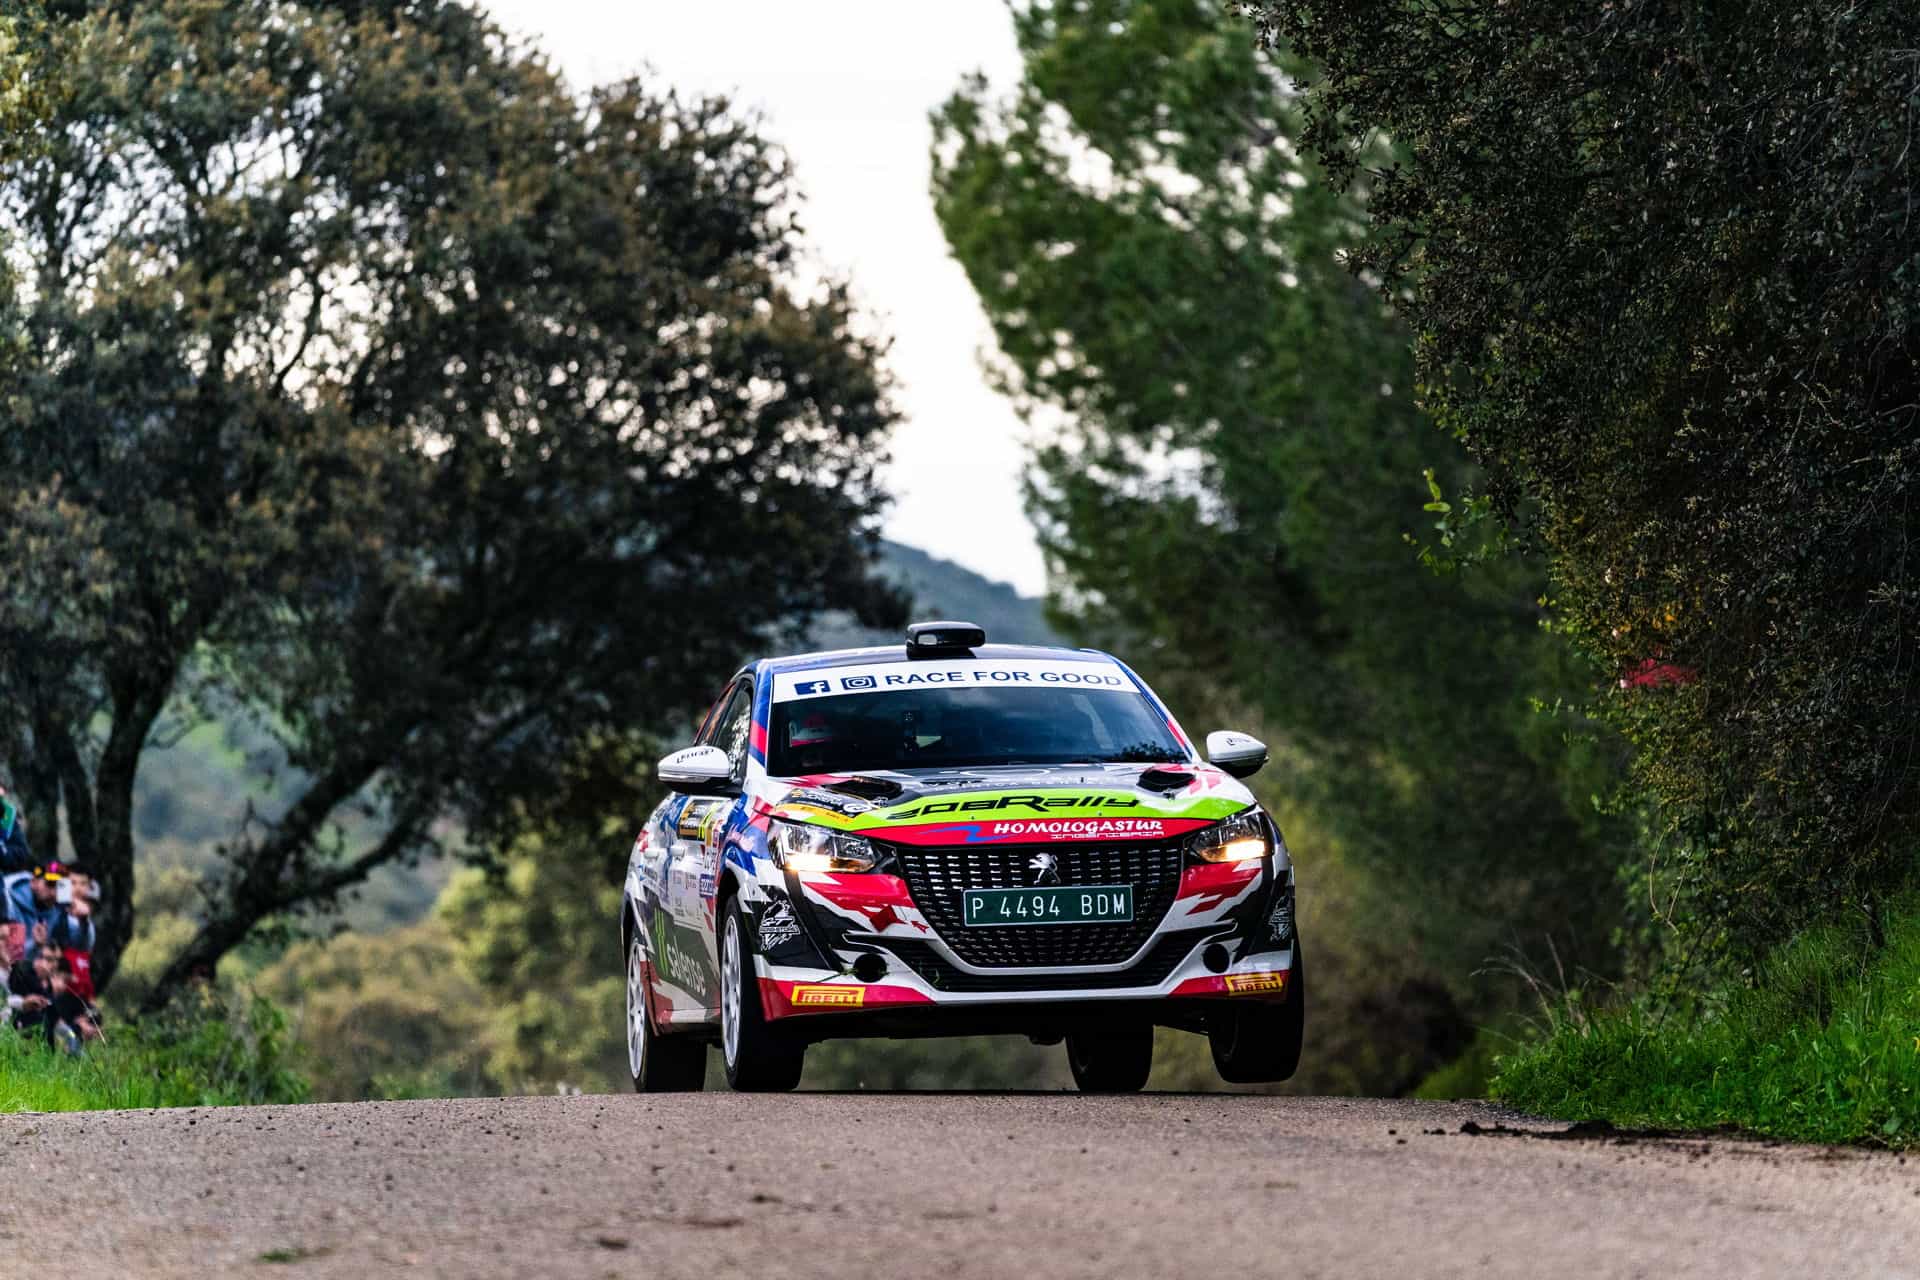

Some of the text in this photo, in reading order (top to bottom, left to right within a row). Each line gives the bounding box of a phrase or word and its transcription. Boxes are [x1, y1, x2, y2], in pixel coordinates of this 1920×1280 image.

[885, 671, 963, 686] RACE
[973, 670, 1030, 683] FOR
[1040, 671, 1122, 687] GOOD
[993, 819, 1164, 836] HOMOLOGASTUR
[971, 892, 1126, 919] P 4494 BDM
